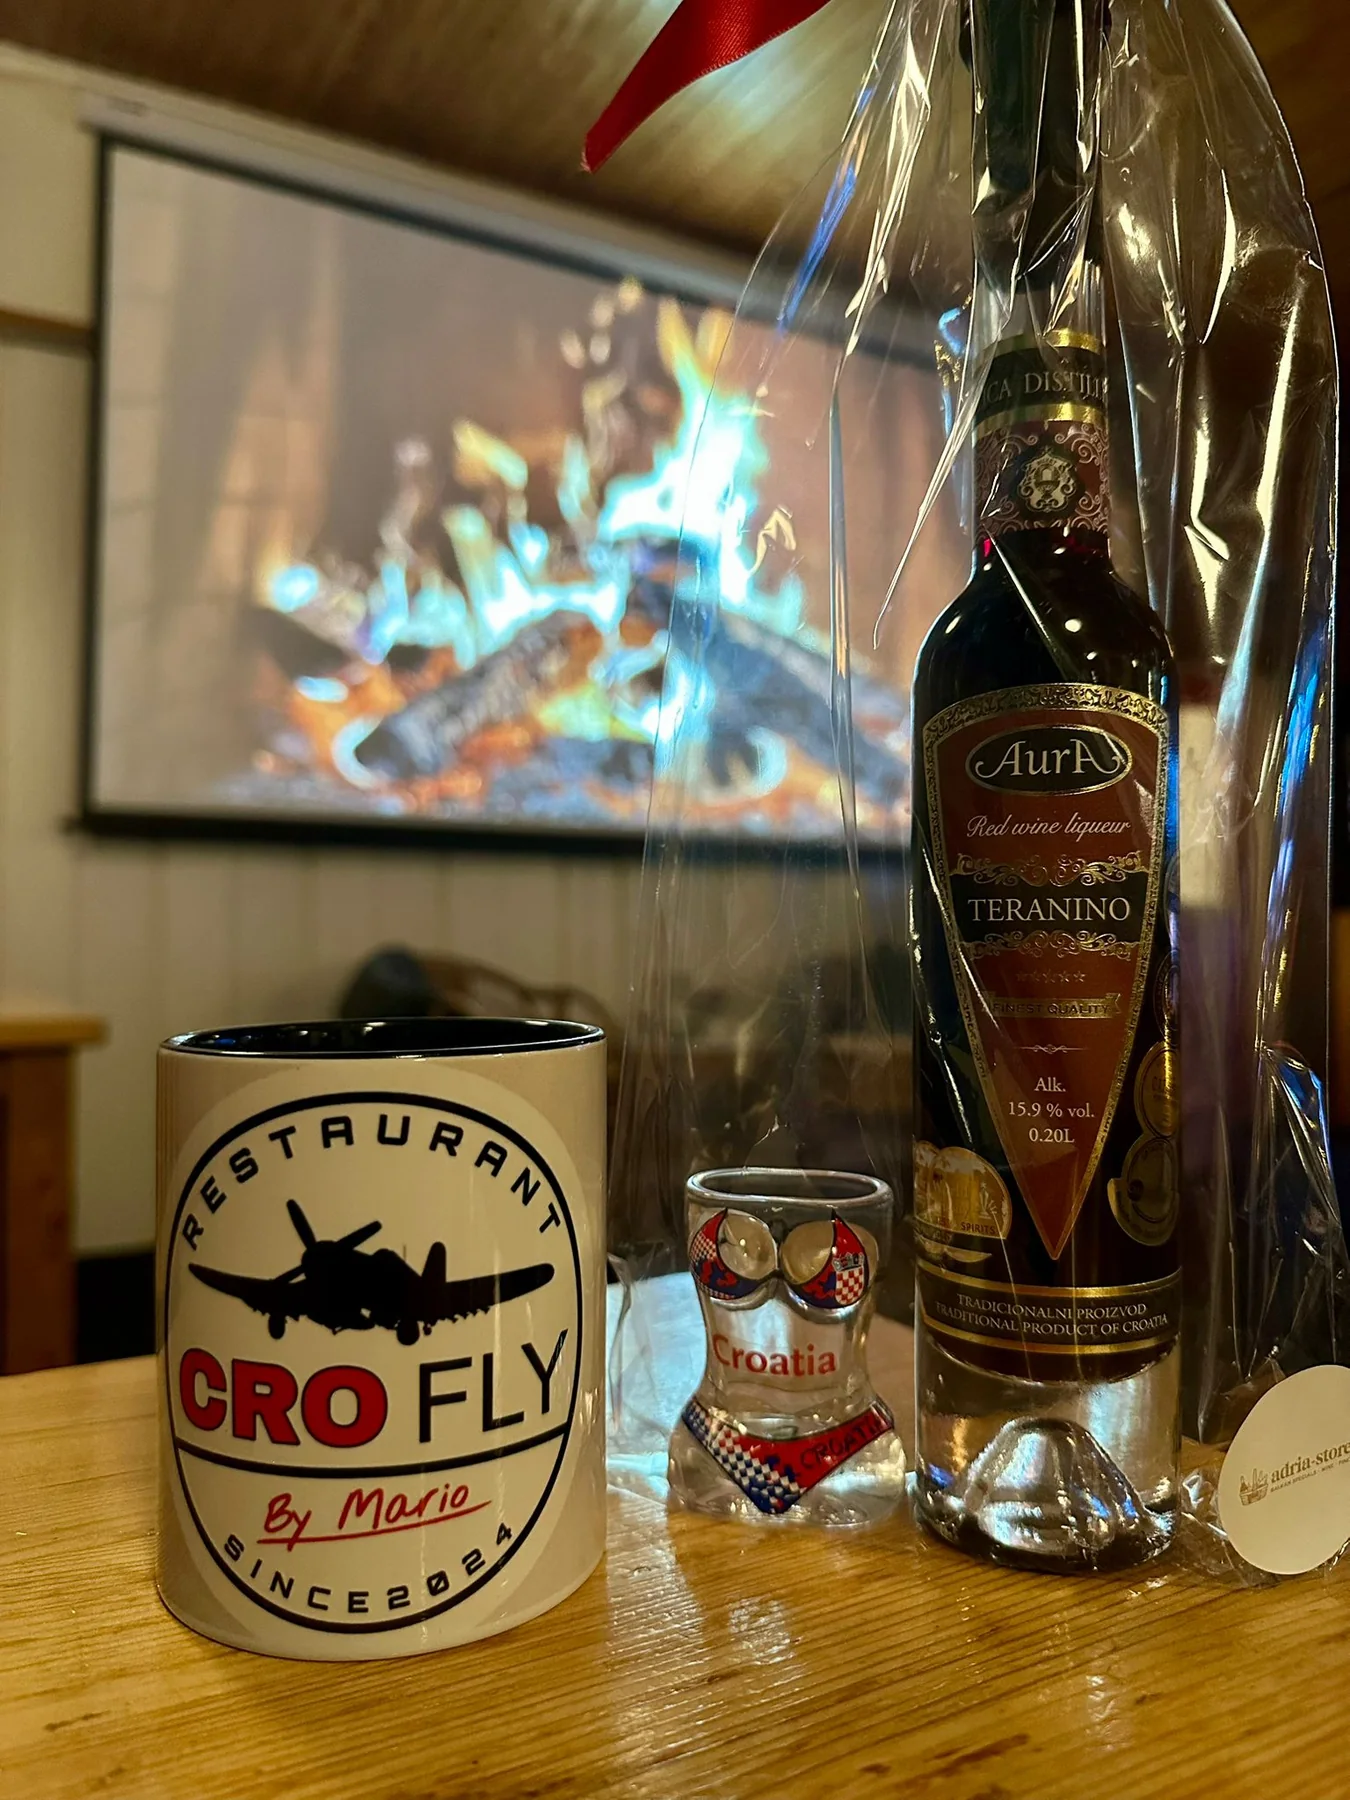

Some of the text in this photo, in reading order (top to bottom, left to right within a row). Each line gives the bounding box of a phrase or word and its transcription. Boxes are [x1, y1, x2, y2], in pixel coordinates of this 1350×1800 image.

[974, 738, 1121, 779] AurA
[967, 812, 1131, 842] Red wine liqueur
[968, 897, 1130, 922] TERANINO
[993, 1002, 1110, 1015] FINEST QUALITY
[1034, 1077, 1066, 1092] Alk.
[1008, 1102, 1095, 1118] 15.9 % vol.
[1029, 1128, 1075, 1143] 0.20L
[181, 1112, 562, 1252] RESTAURANT
[960, 1221, 996, 1235] SPIRITS
[936, 1302, 1168, 1336] TRADITIONAL PRODUCT OF CROATIA
[956, 1294, 1147, 1320] TRADICIONALNI PROIZVOD
[712, 1334, 836, 1377] Croatia
[179, 1328, 568, 1448] CRO FLY
[264, 1484, 469, 1552] By Mario
